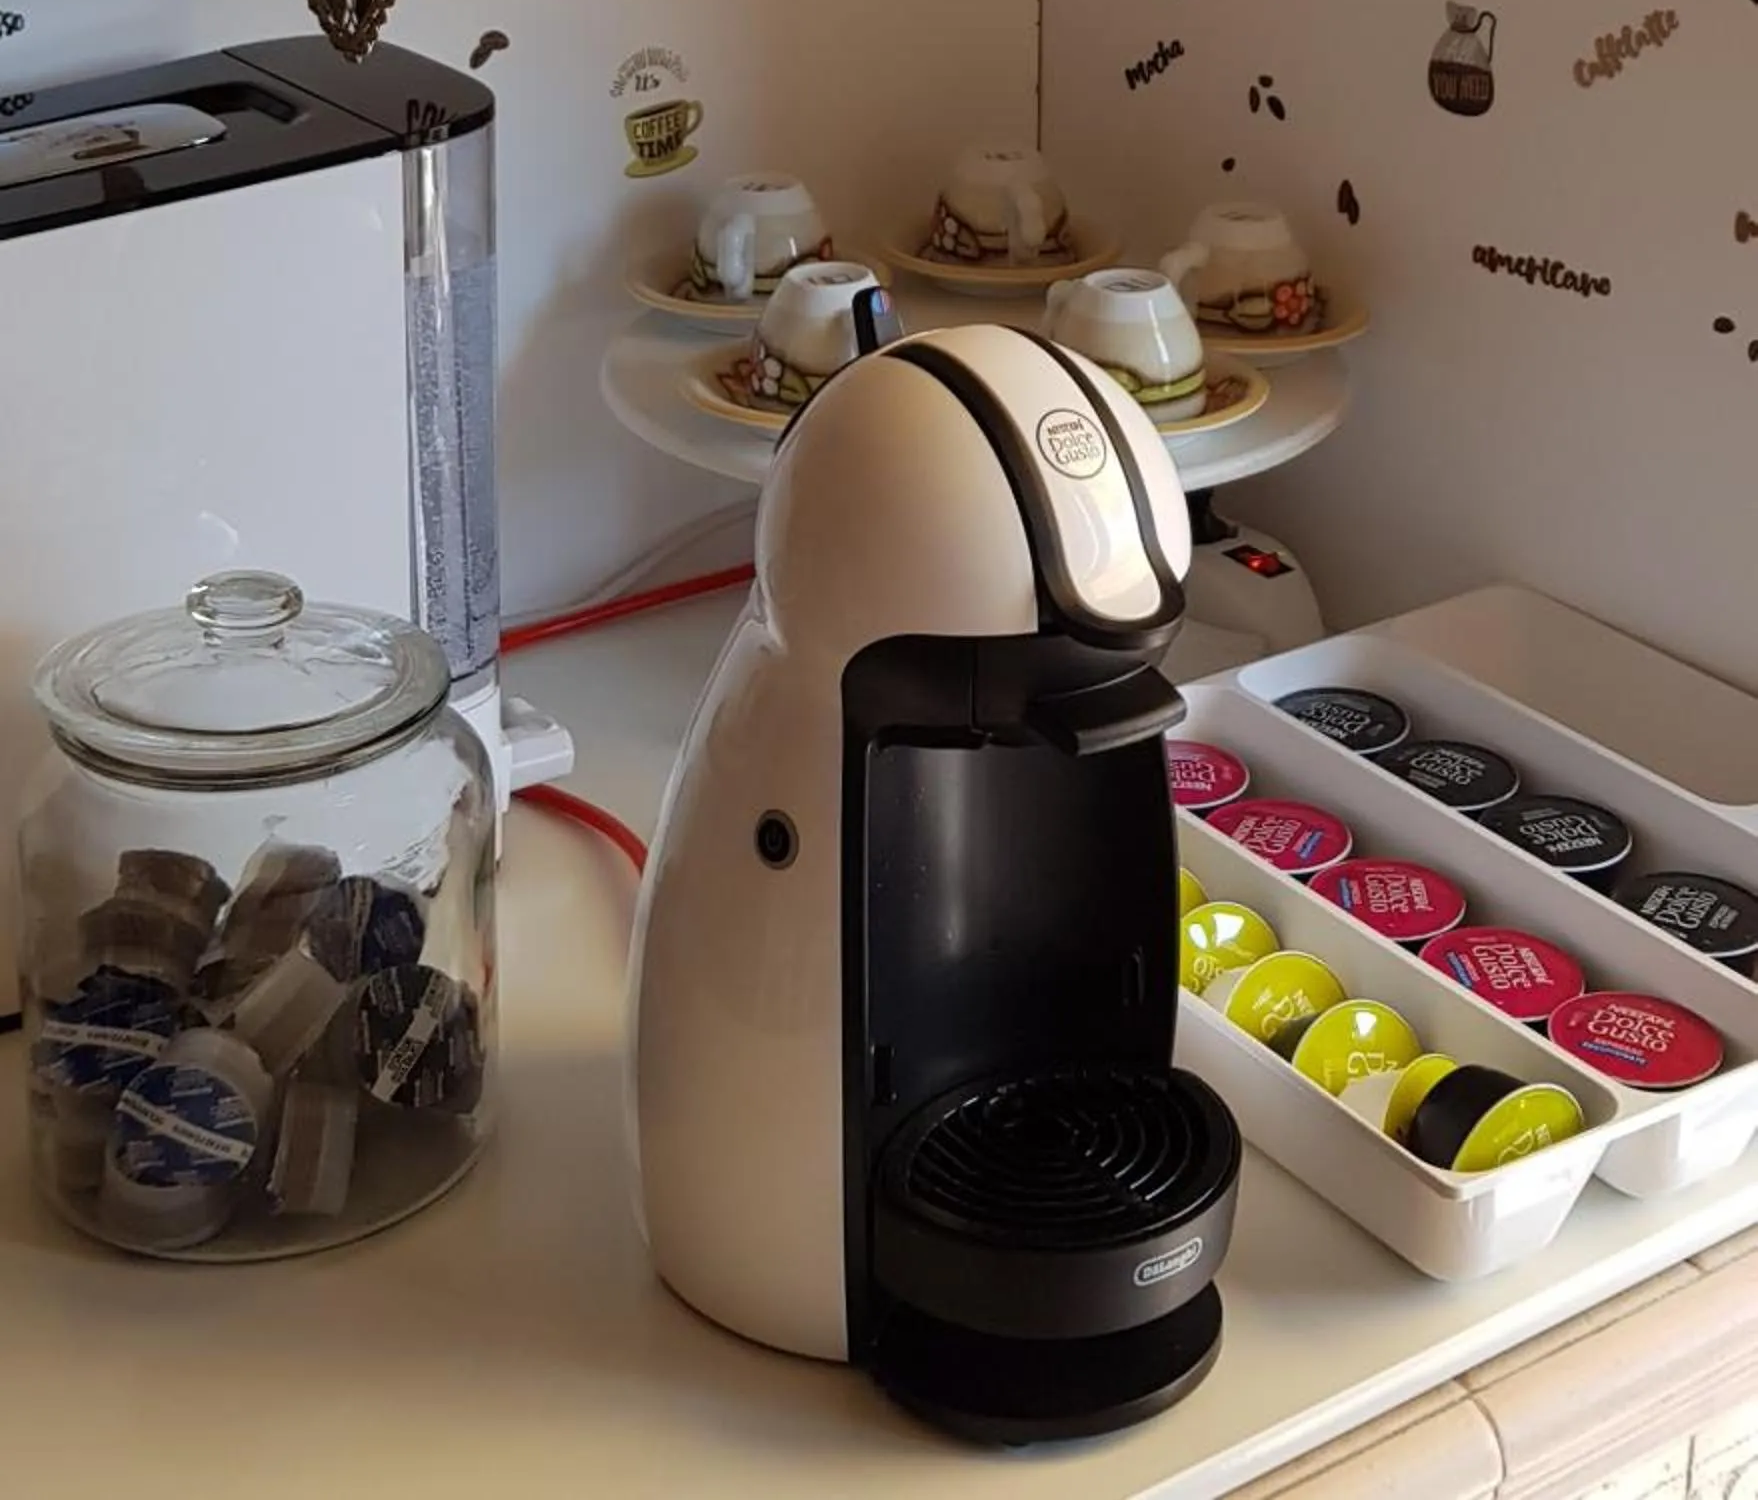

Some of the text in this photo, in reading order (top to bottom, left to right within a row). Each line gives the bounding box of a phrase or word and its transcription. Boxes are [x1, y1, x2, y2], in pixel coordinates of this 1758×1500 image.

[633, 110, 682, 140] COFFEE
[1471, 944, 1512, 990] Gusto
[1488, 943, 1533, 989] Dolce
[1587, 1021, 1669, 1053] Gusto
[1594, 1009, 1676, 1043] Dolce
